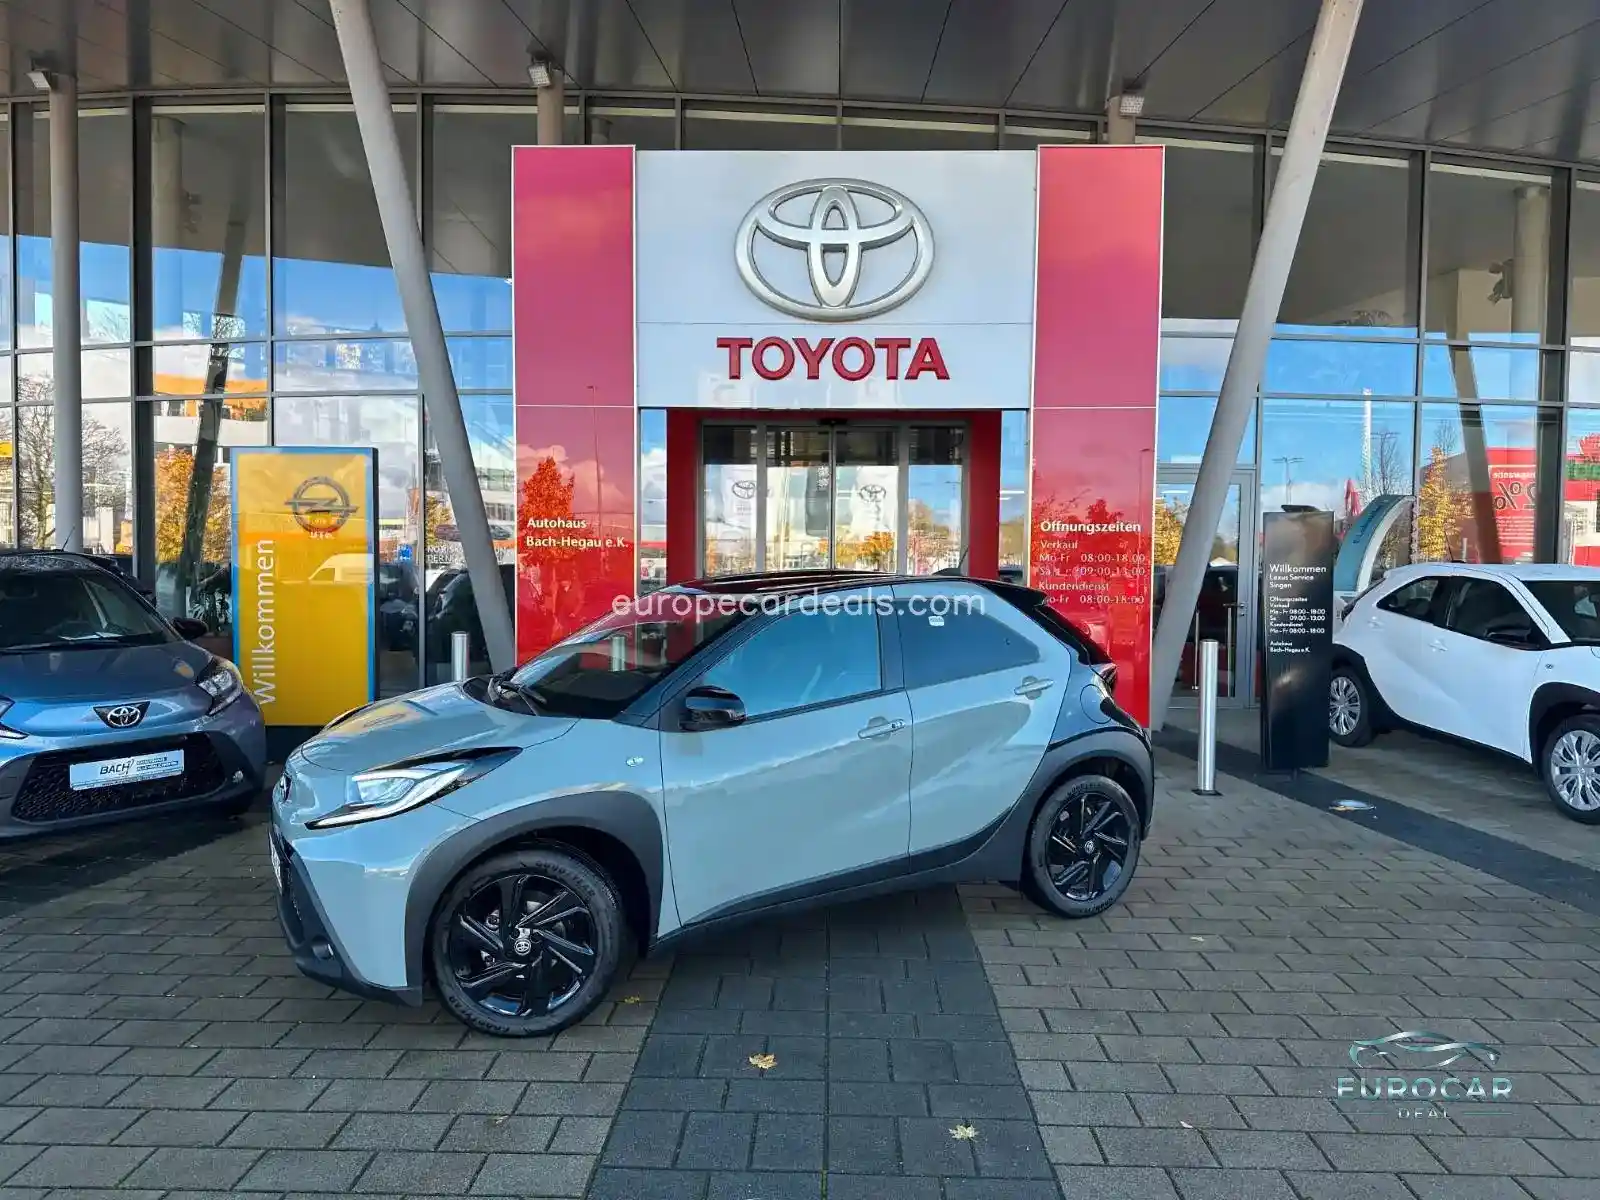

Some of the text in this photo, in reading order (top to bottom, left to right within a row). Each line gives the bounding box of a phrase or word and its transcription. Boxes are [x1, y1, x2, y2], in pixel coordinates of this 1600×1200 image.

[716, 336, 950, 381] TOYOTA
[526, 517, 587, 528] Autohaus
[1040, 520, 1141, 535] Öffnungszeiten
[526, 536, 629, 550] Bach-Hegau e.K.
[1040, 540, 1078, 549] Verkauf
[1269, 563, 1326, 573] Willkommen
[1039, 581, 1109, 590] Kundendienst
[251, 539, 276, 705] Willkommen
[100, 762, 131, 775] BACH
